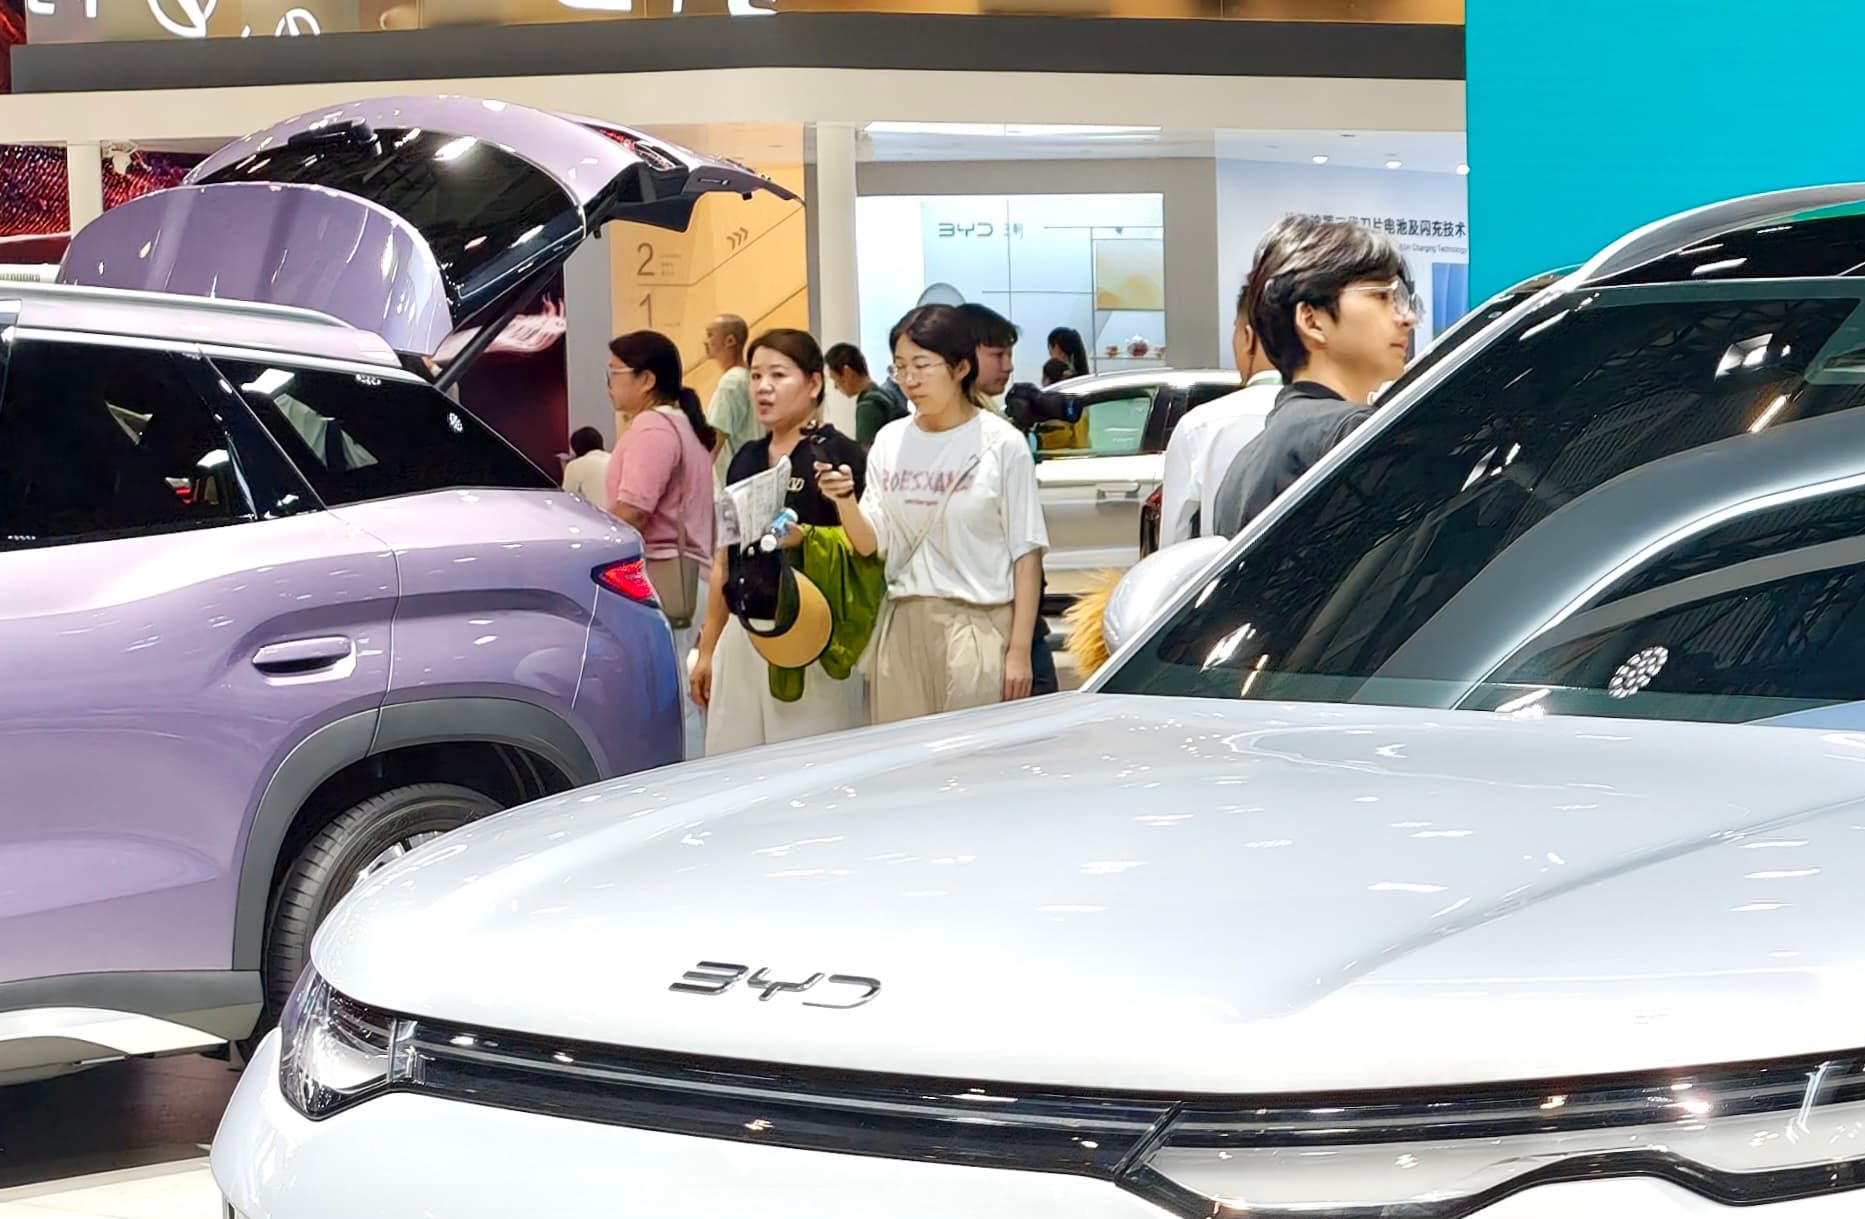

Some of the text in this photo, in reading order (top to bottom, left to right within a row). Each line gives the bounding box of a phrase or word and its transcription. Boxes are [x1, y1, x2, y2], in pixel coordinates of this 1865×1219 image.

[938, 222, 993, 238] BYD
[637, 242, 655, 276] 2
[639, 293, 652, 328] 1
[668, 960, 882, 1009] BYD
